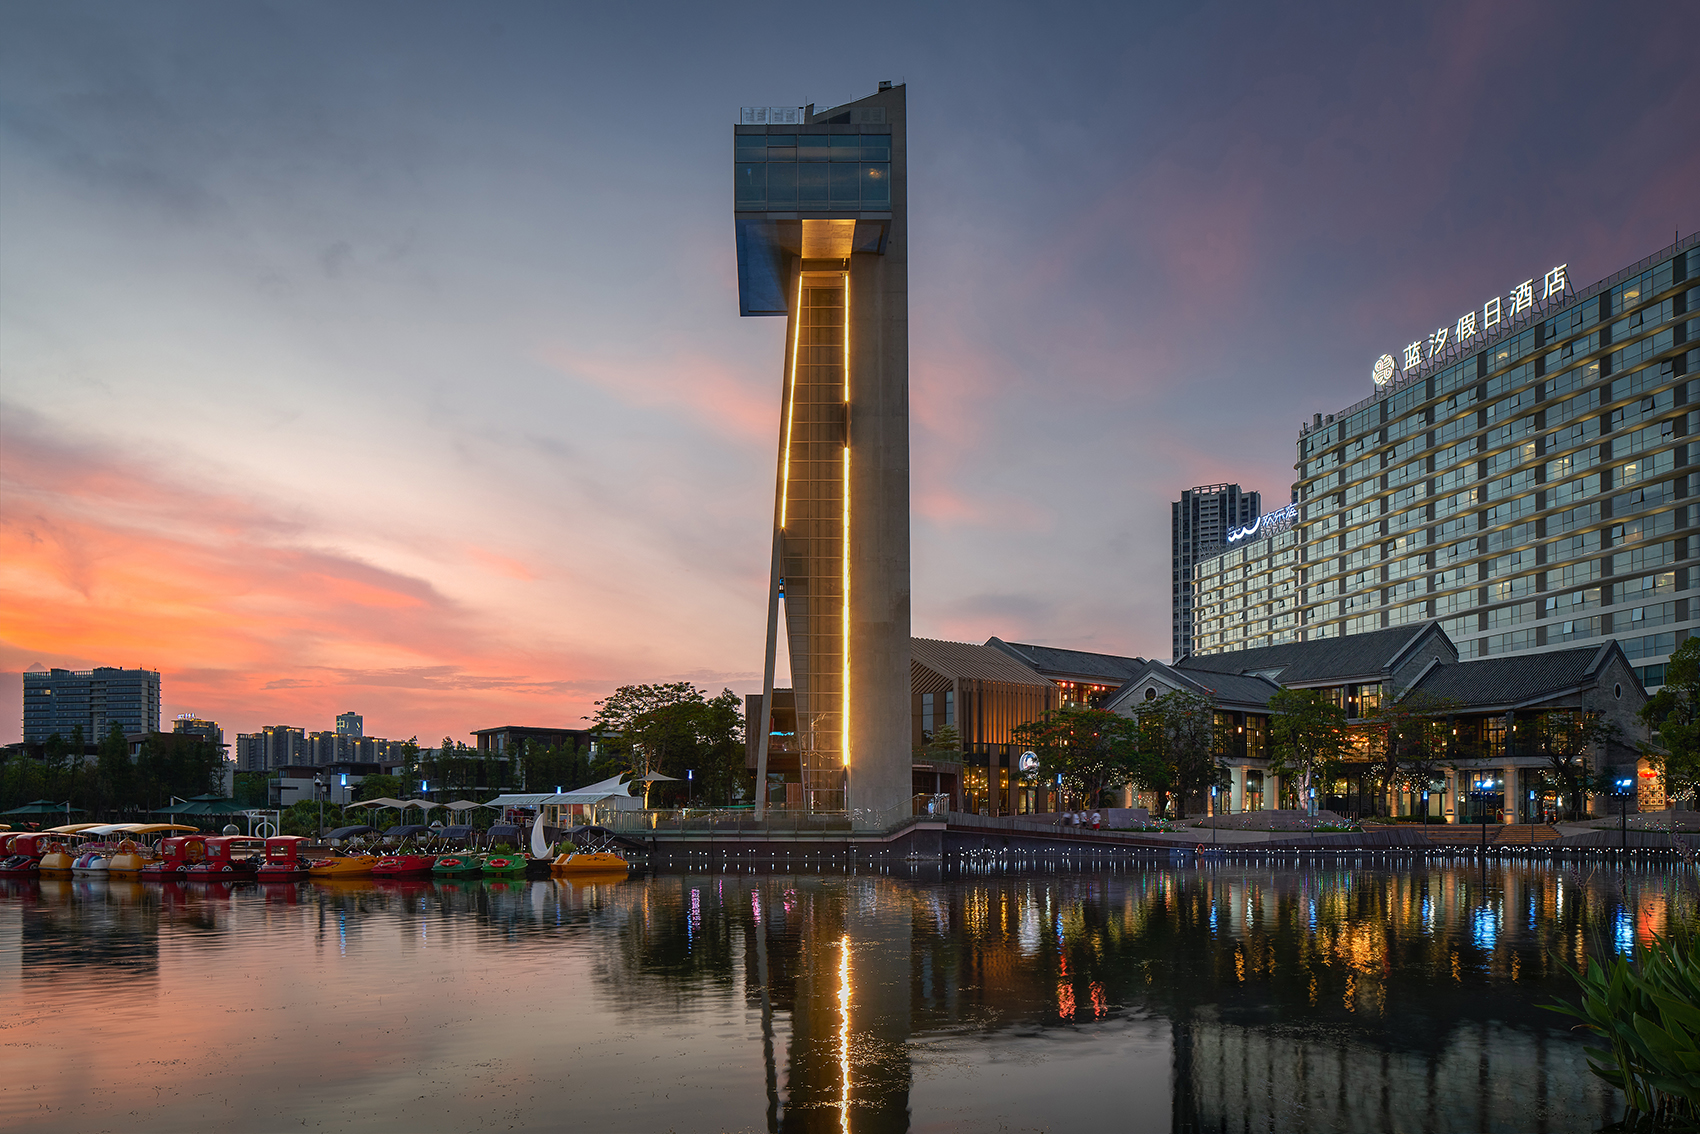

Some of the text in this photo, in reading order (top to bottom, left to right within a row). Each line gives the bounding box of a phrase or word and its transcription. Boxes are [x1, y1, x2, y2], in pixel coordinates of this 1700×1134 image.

[1403, 263, 1568, 371] 蓝汐假日酒店
